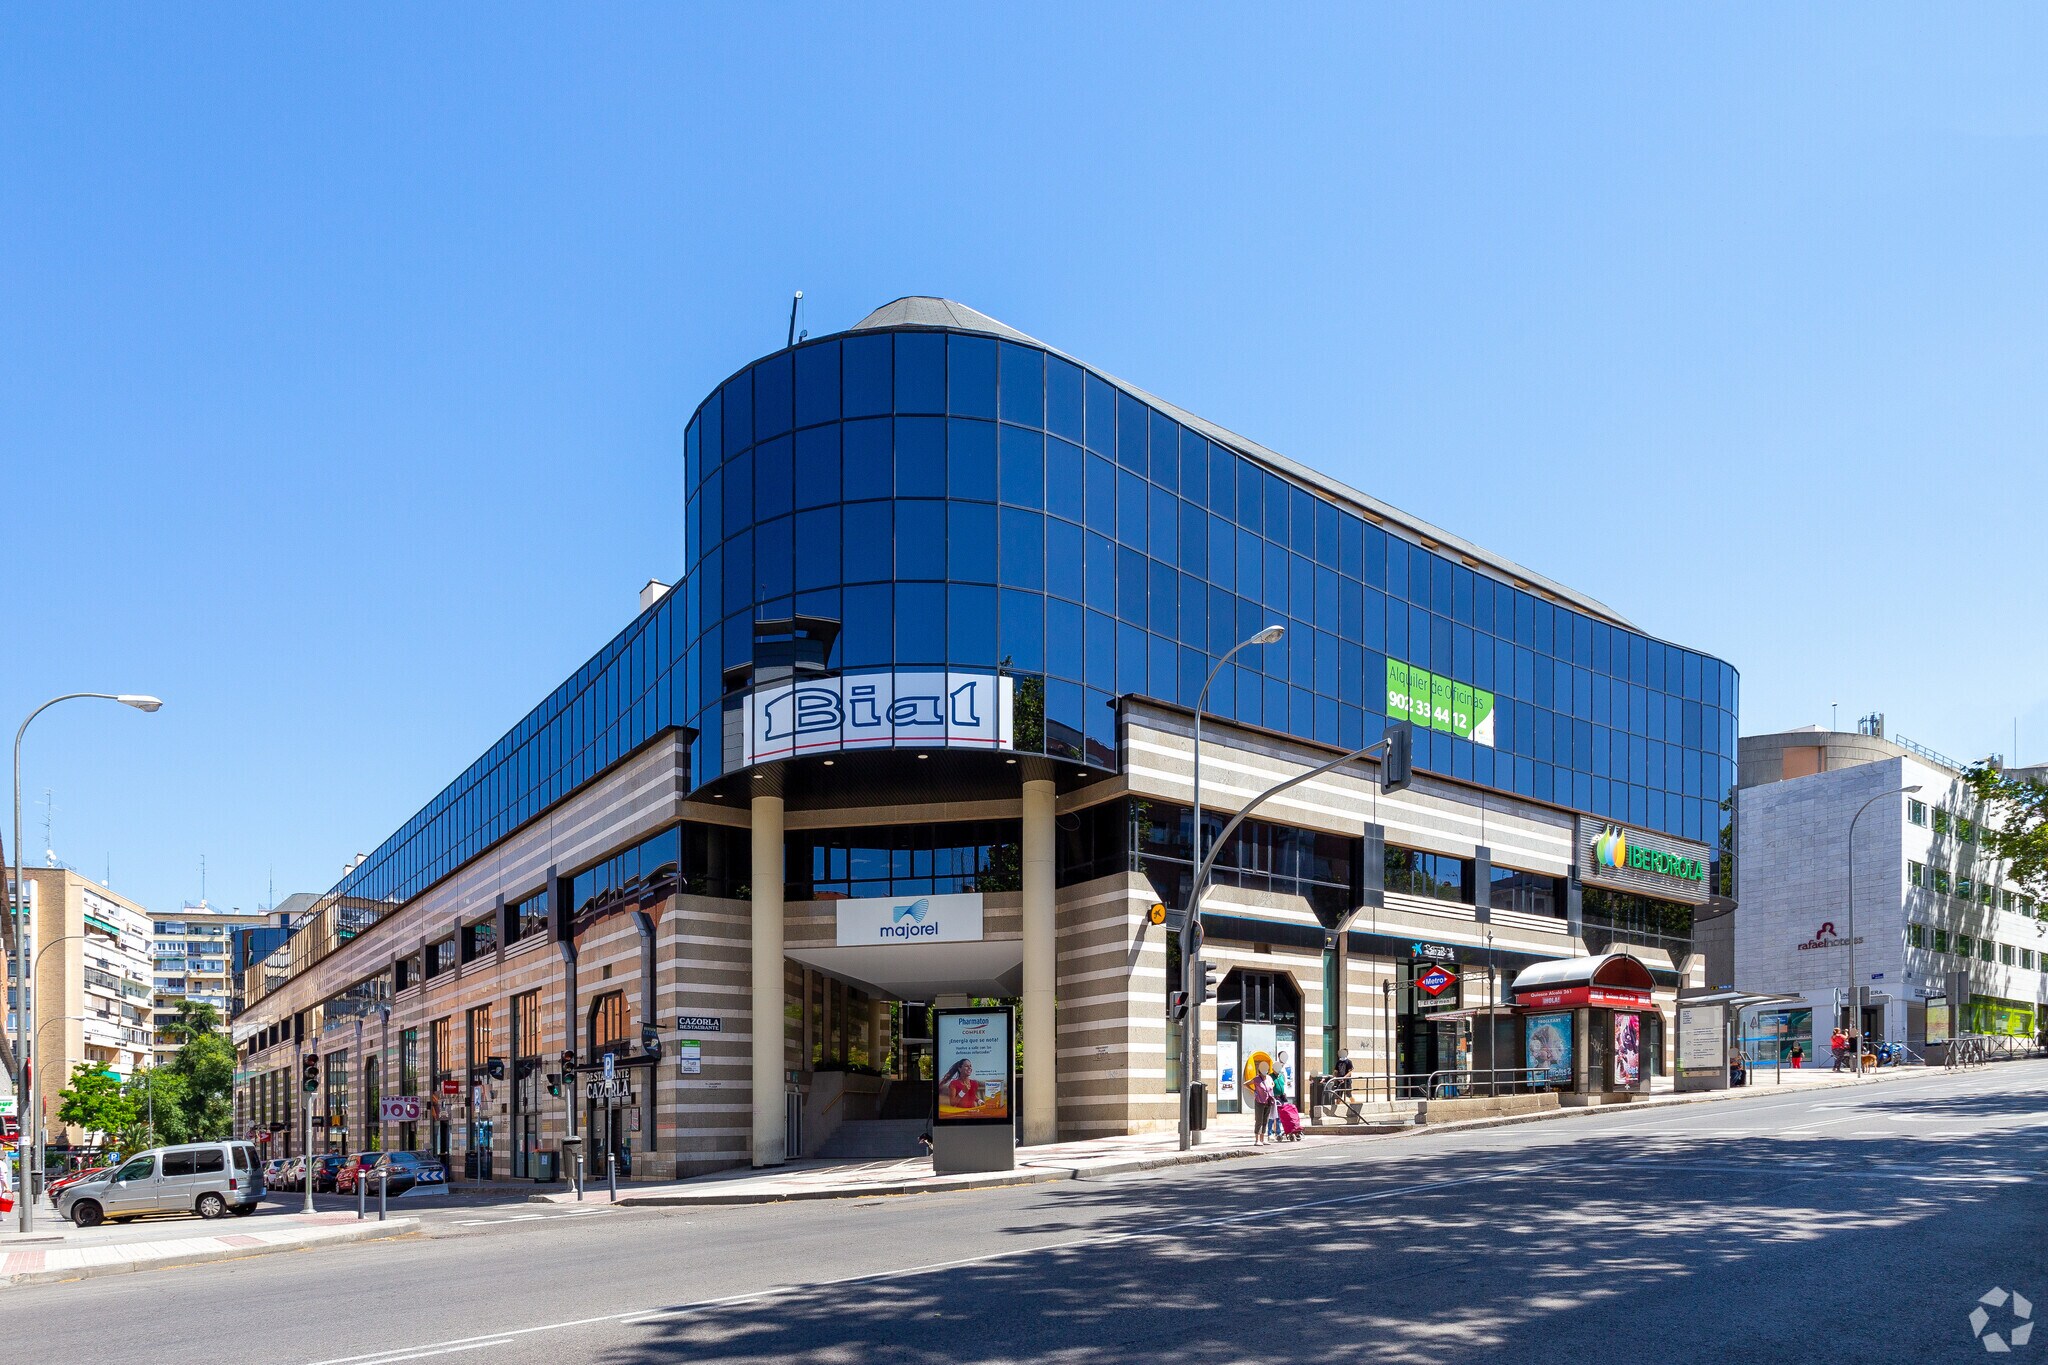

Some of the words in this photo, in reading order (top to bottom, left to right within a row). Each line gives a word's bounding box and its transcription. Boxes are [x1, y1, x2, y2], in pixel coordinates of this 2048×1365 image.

[1389, 666, 1428, 690] Alquiler
[1431, 681, 1443, 697] de
[1444, 685, 1484, 710] Oficinas
[765, 681, 981, 742] Bial
[1388, 691, 1414, 713] 902
[1415, 700, 1431, 718] 33
[1433, 706, 1450, 724] 44
[1452, 712, 1467, 729] 12
[1628, 844, 1704, 881] IBERDROLA
[879, 922, 939, 940] majorel
[1425, 975, 1444, 985] Metro
[679, 1017, 719, 1026] CAZORLA
[958, 1017, 989, 1025] Pharmaton
[587, 1069, 629, 1082] RESTAANTE
